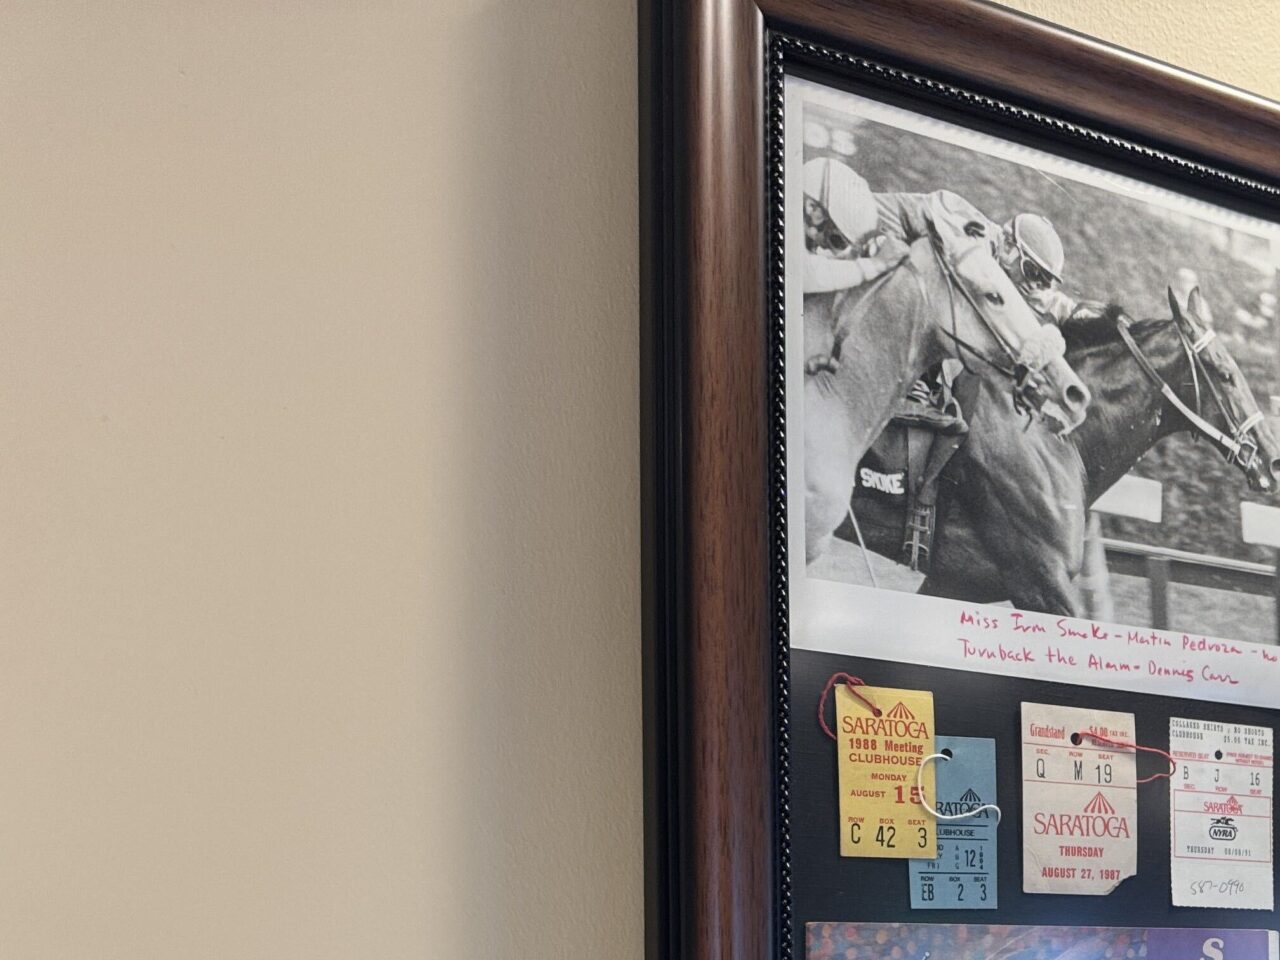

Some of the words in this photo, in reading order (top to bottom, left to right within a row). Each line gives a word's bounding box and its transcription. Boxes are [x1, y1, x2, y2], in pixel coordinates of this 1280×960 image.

[960, 610, 999, 629] Miss
[1182, 635, 1242, 654] Pedroza
[957, 638, 1036, 662] Turnback
[1045, 646, 1077, 666] the
[842, 715, 929, 739] SARATOGA
[1030, 723, 1065, 739] Grandstand
[849, 738, 877, 750] 1988
[884, 739, 923, 755] Meeting
[849, 752, 922, 766] CLUBHOUSE
[871, 773, 907, 782] MONDAY
[1036, 758, 1046, 778] Q
[1073, 760, 1083, 781] M
[1095, 763, 1112, 784] 19
[1183, 766, 1189, 780] B
[1214, 769, 1220, 782] J
[1250, 772, 1260, 786] 16
[850, 790, 886, 798] AUGUST
[894, 785, 925, 805] 15
[1203, 801, 1243, 815] SARATOGA
[1033, 812, 1130, 838] SARATOGA
[1212, 829, 1233, 838] NYRA
[851, 823, 861, 844] C
[875, 826, 896, 848] 42
[918, 827, 927, 848] 3
[1059, 846, 1104, 858] THURSDAY
[1187, 845, 1214, 854] THURSDAY
[964, 850, 976, 868] 12
[1041, 867, 1076, 878] AUGUST
[1081, 868, 1094, 880] 27,
[1099, 869, 1121, 880] 1987
[921, 883, 934, 901] EB
[957, 883, 964, 901] 2
[980, 883, 987, 901] 3
